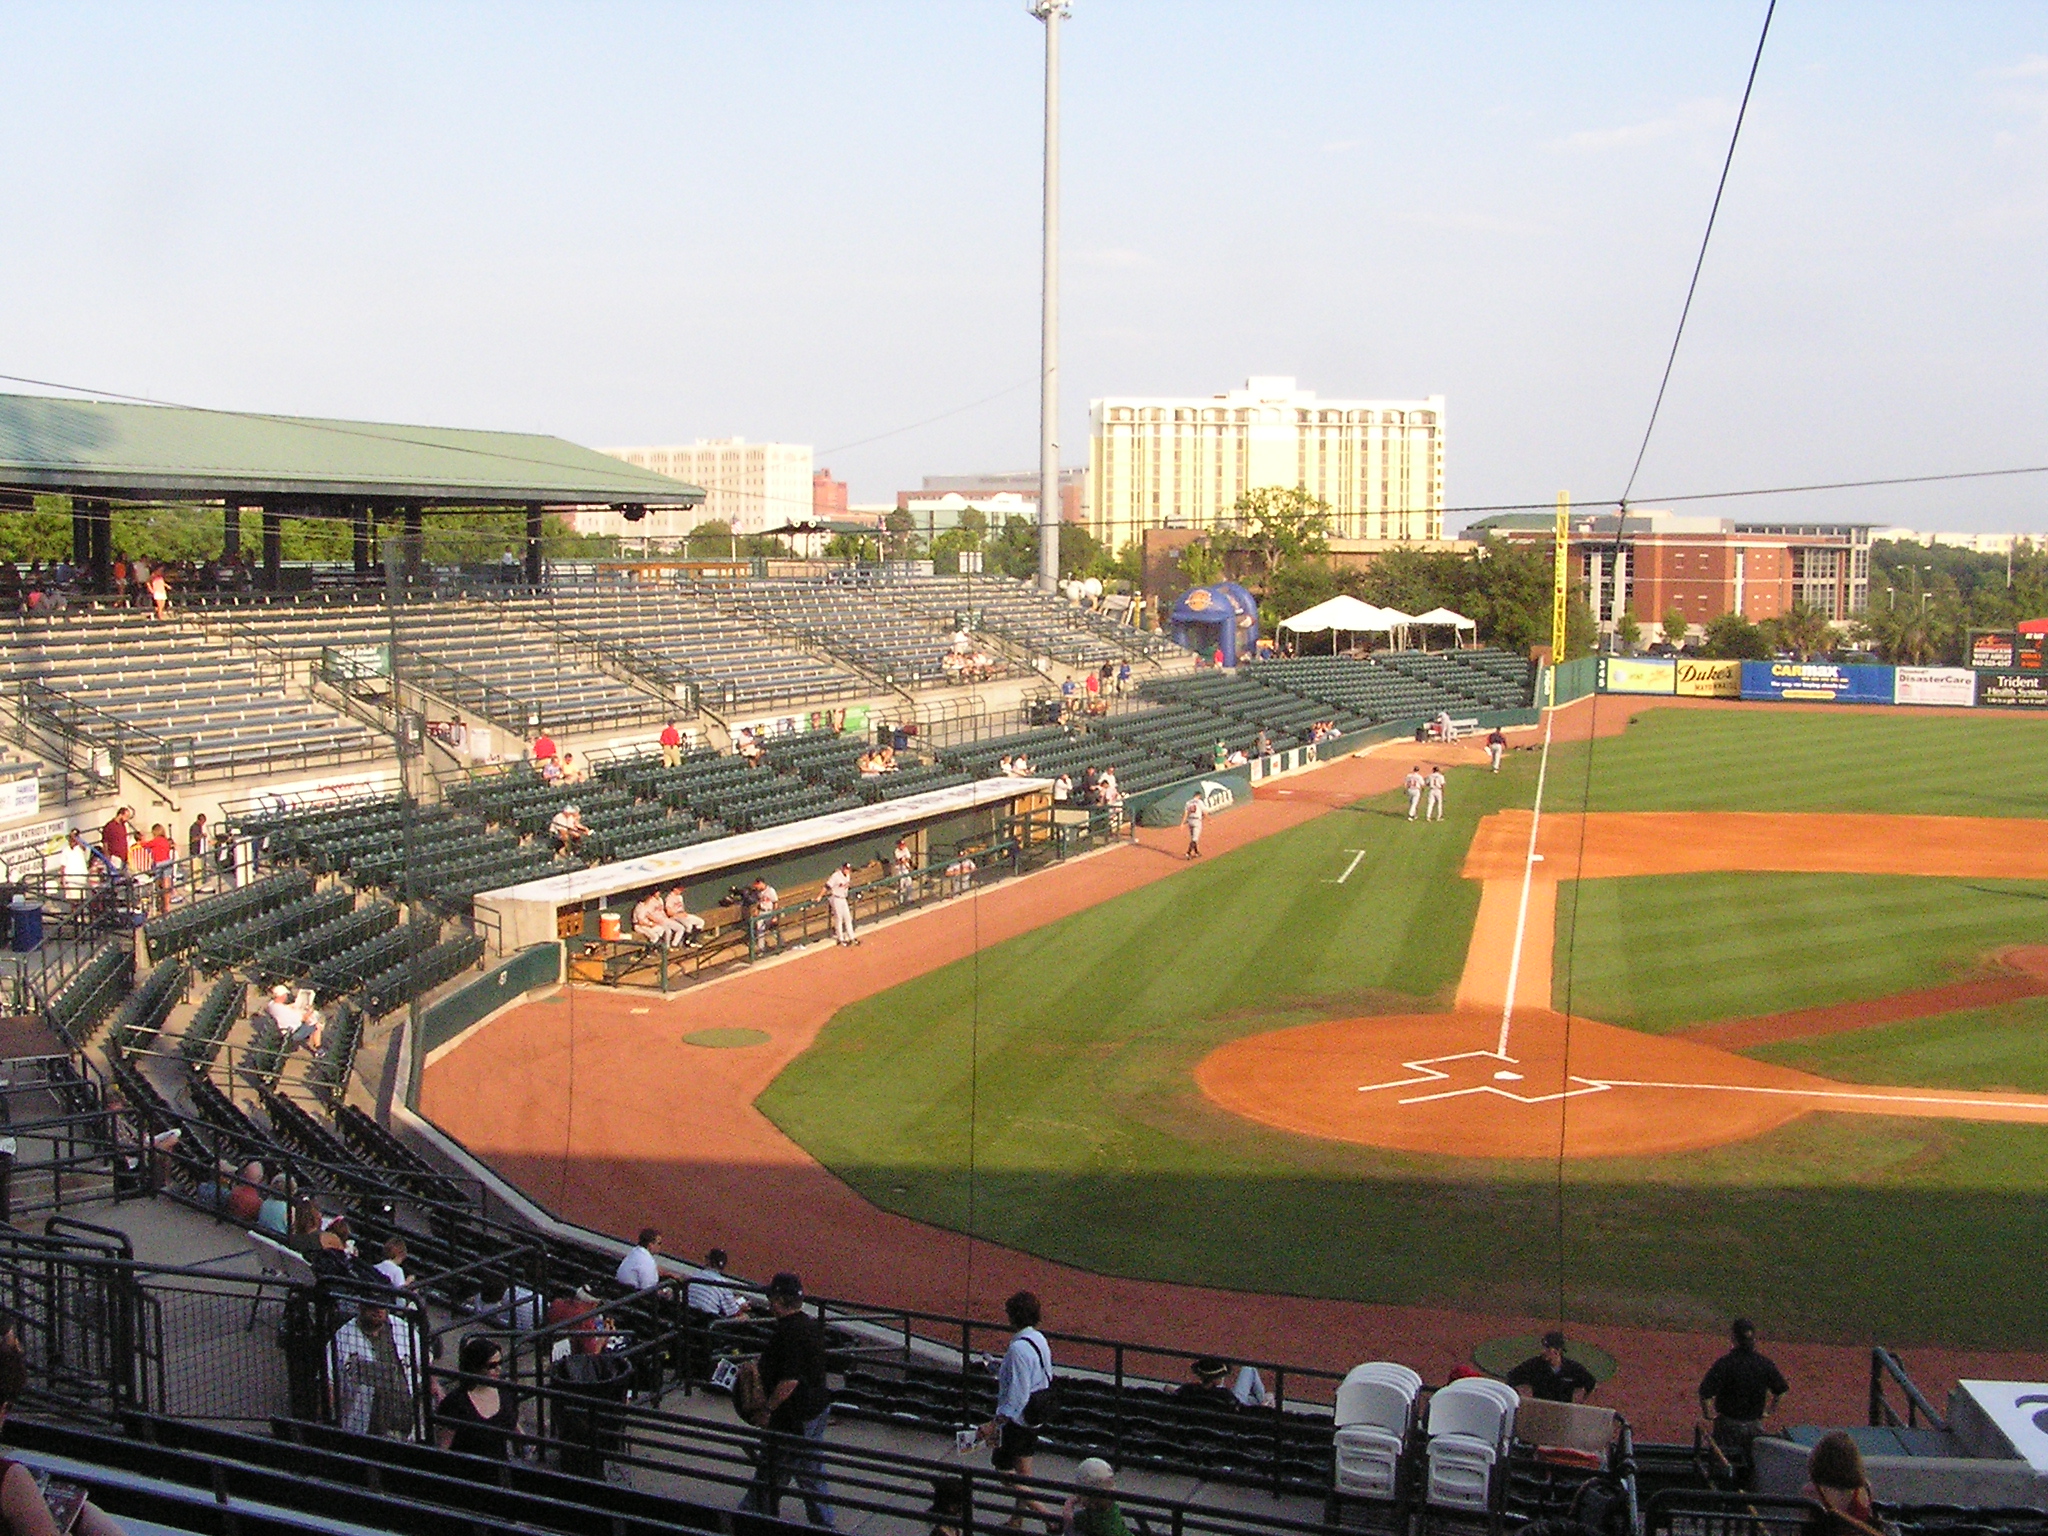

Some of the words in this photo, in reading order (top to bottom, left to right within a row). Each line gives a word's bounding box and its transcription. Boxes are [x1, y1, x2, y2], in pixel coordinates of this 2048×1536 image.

[1678, 665, 1731, 682] Duke's
[1899, 674, 1972, 685] DisasterCare
[1997, 676, 2039, 688] Trident
